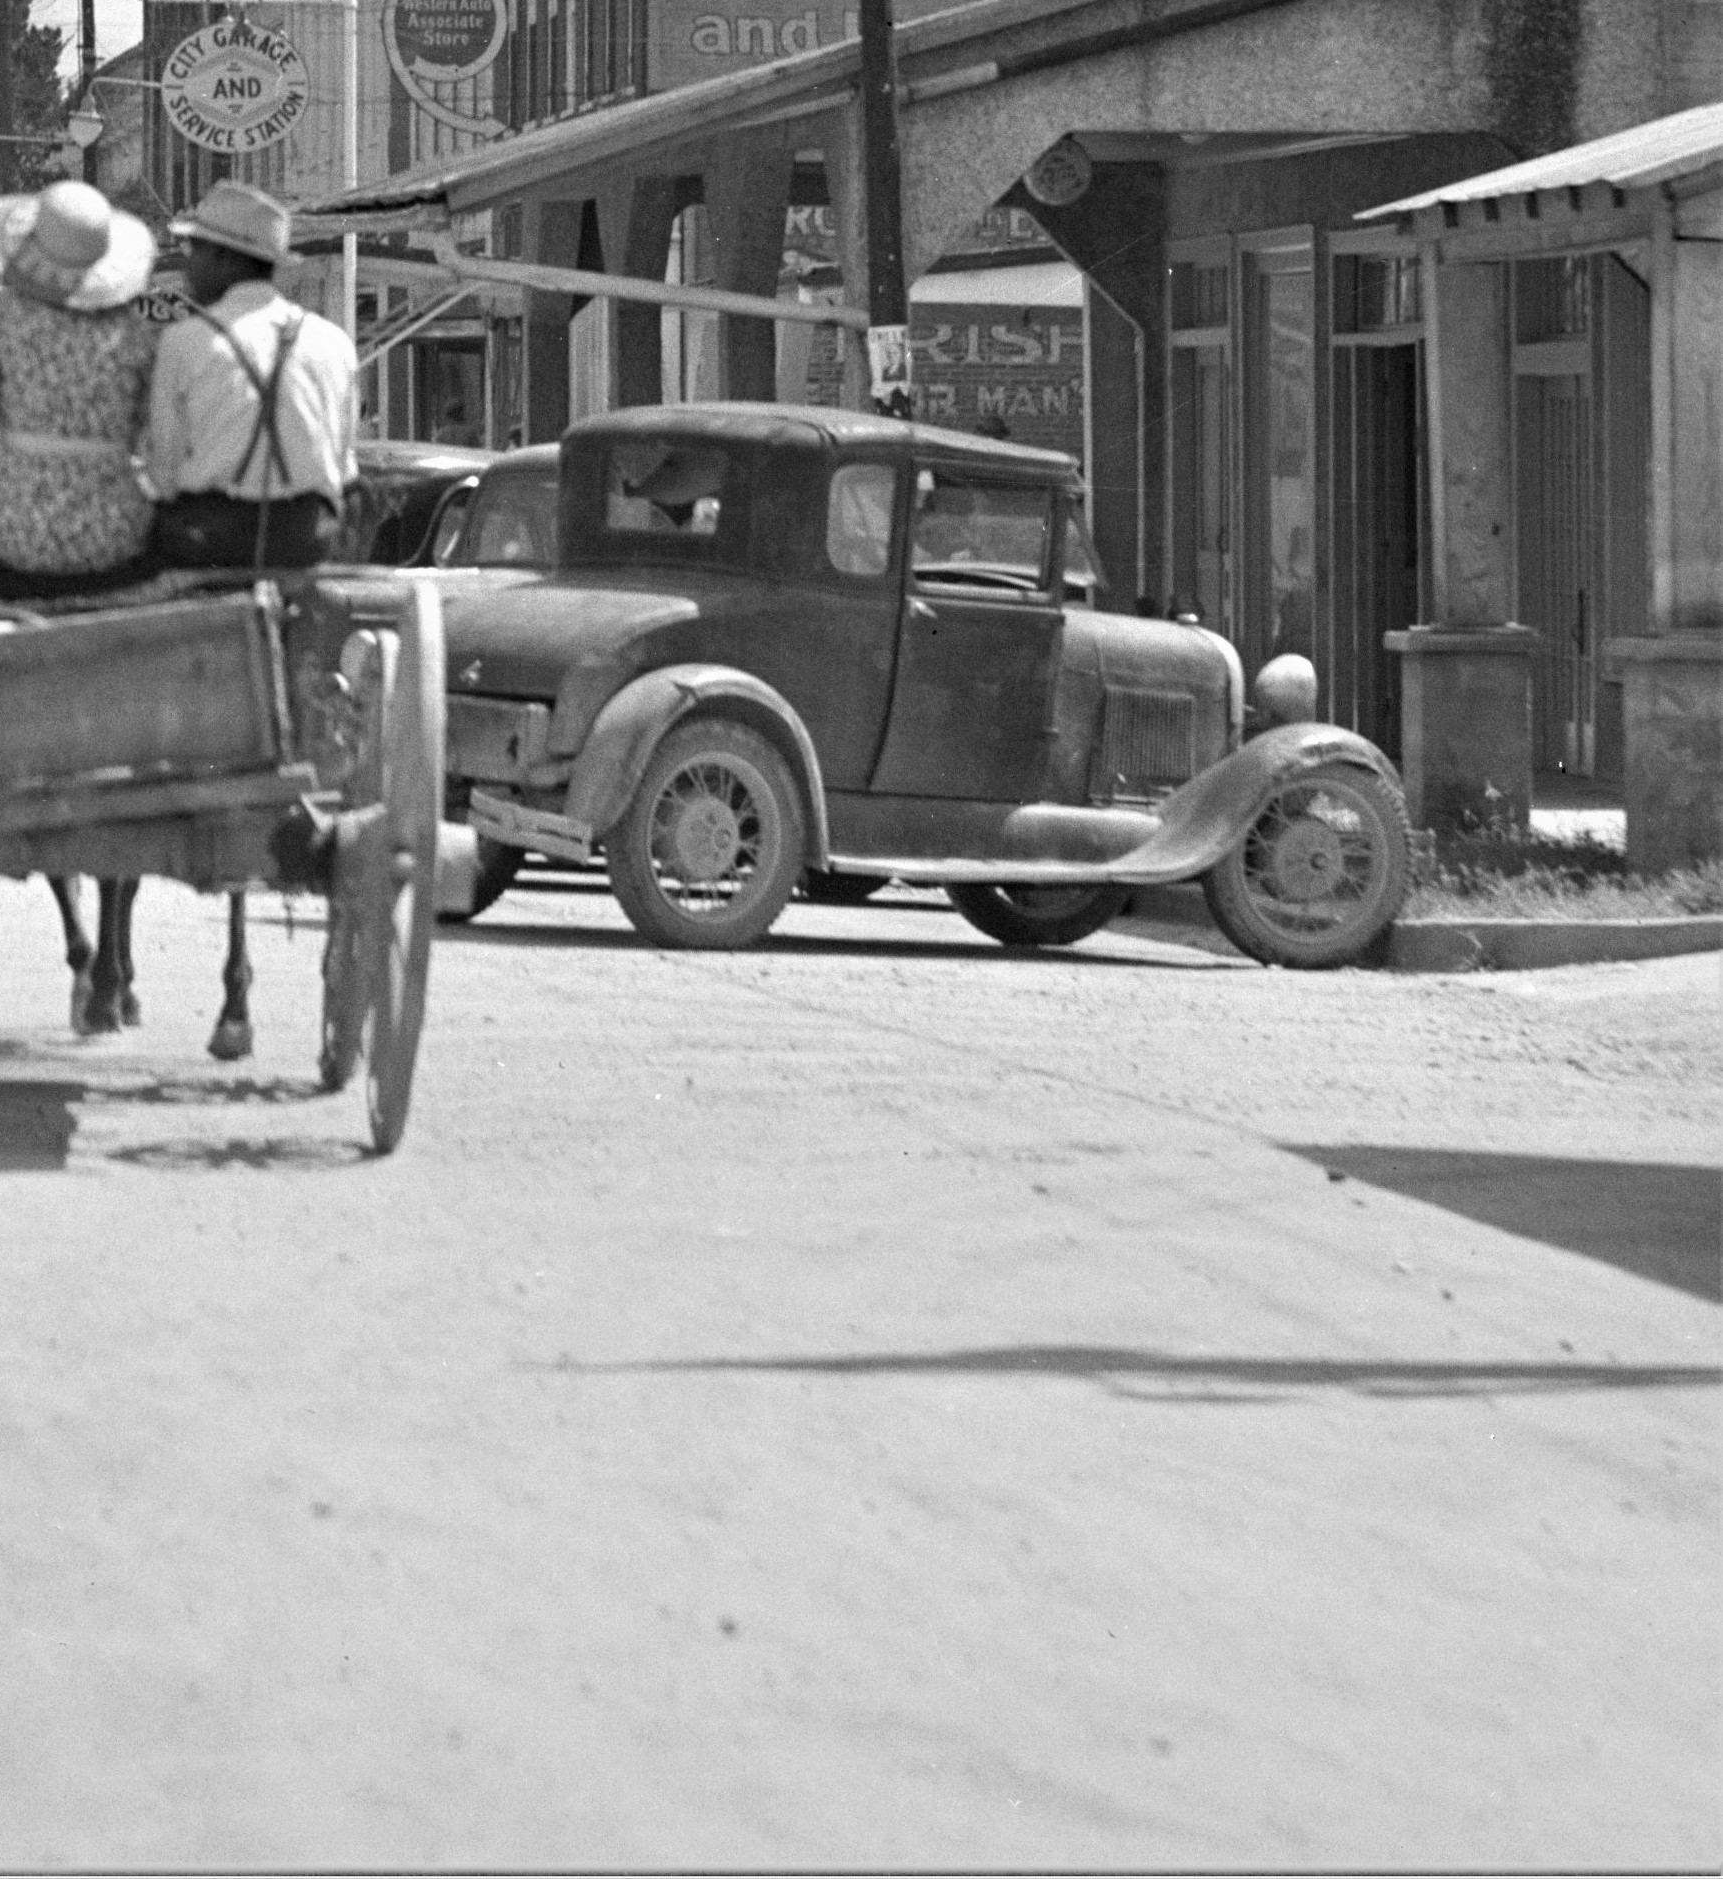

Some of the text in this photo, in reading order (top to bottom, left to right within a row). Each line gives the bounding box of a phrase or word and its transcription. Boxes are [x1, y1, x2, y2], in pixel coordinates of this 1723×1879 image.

[407, 11, 484, 30] Associate
[423, 29, 471, 47] Store
[169, 26, 298, 80] CITY GARAGE
[212, 77, 263, 100] AND
[169, 89, 305, 149] SERVICE STATION
